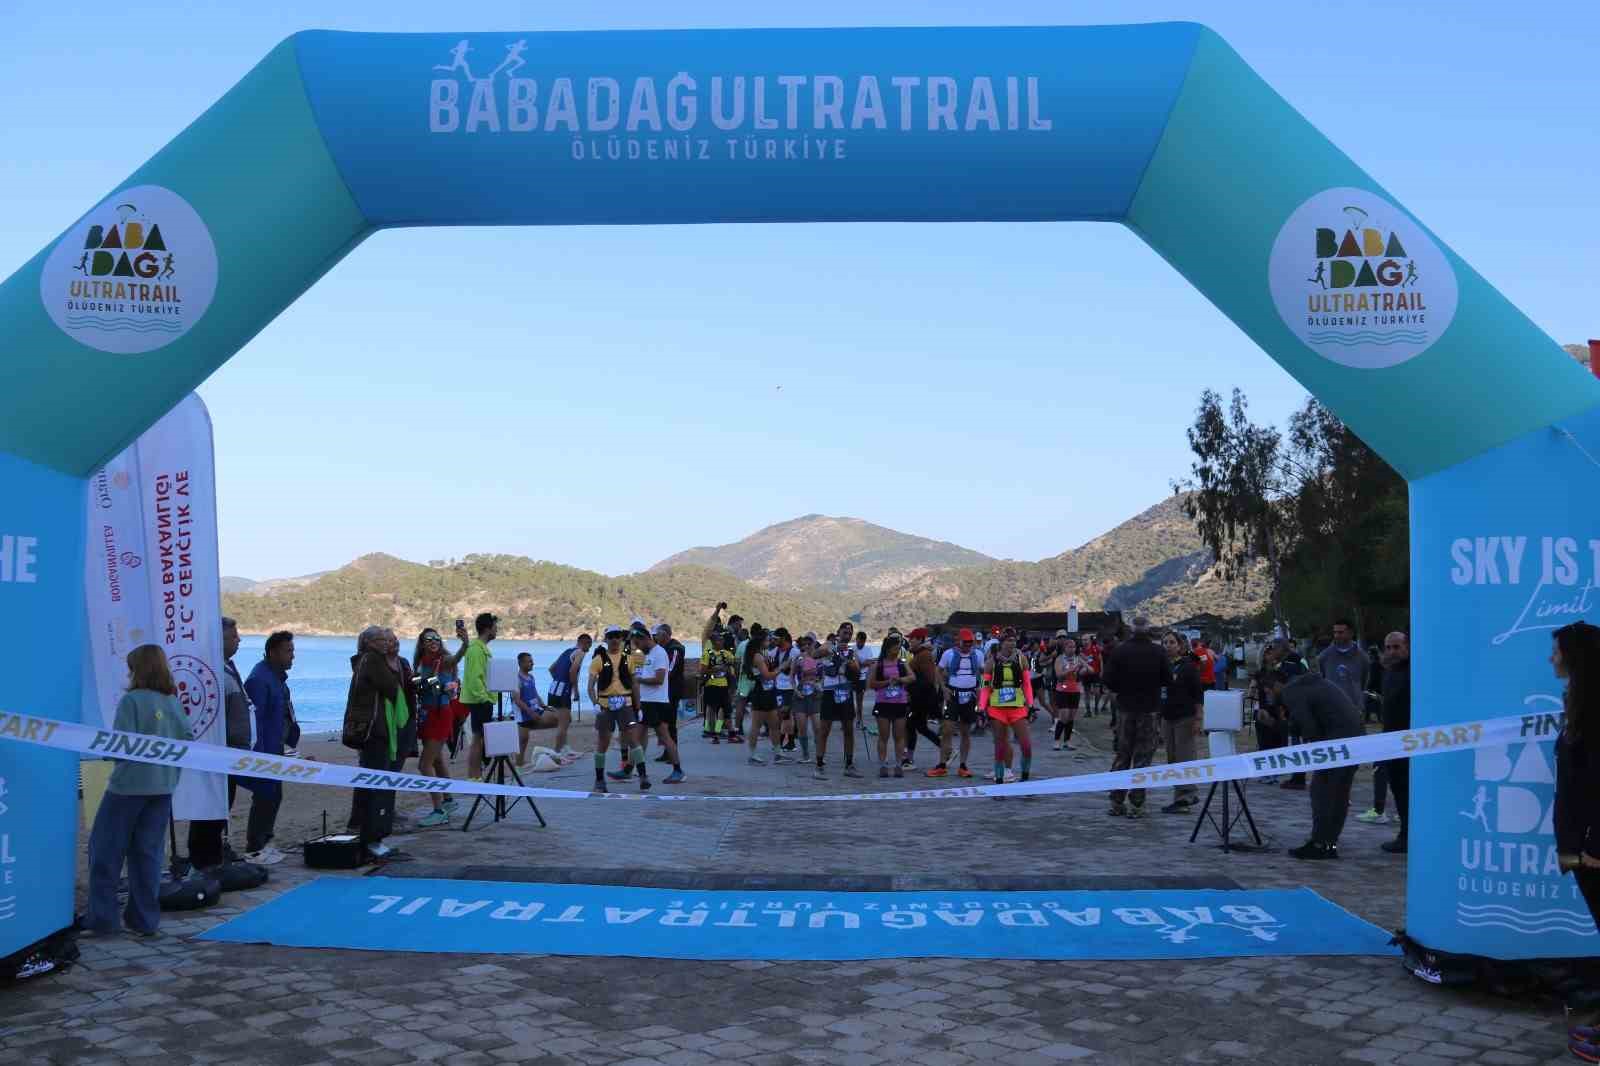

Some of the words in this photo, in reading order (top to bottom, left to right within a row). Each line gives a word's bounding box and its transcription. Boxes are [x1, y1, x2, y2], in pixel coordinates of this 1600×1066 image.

[571, 135, 711, 161] ÖLÜDENİZ
[727, 134, 847, 160] TÜRKİYE
[84, 222, 167, 251] BABA
[1315, 227, 1408, 258] BABA
[70, 280, 181, 303] ULTRATRAIL
[1308, 292, 1427, 313] ULTRATRAIL
[1451, 536, 1527, 586] SKY
[1541, 536, 1579, 586] IS
[1491, 577, 1600, 645] Limit
[88, 731, 189, 762] FINISH
[230, 756, 322, 778] START
[350, 772, 454, 792] FINISH
[1131, 764, 1217, 785] START
[1254, 744, 1350, 771] FINISH
[1401, 723, 1484, 751] START
[1520, 712, 1568, 737] FIN
[1458, 875, 1560, 900] ÖLÜDENİZ
